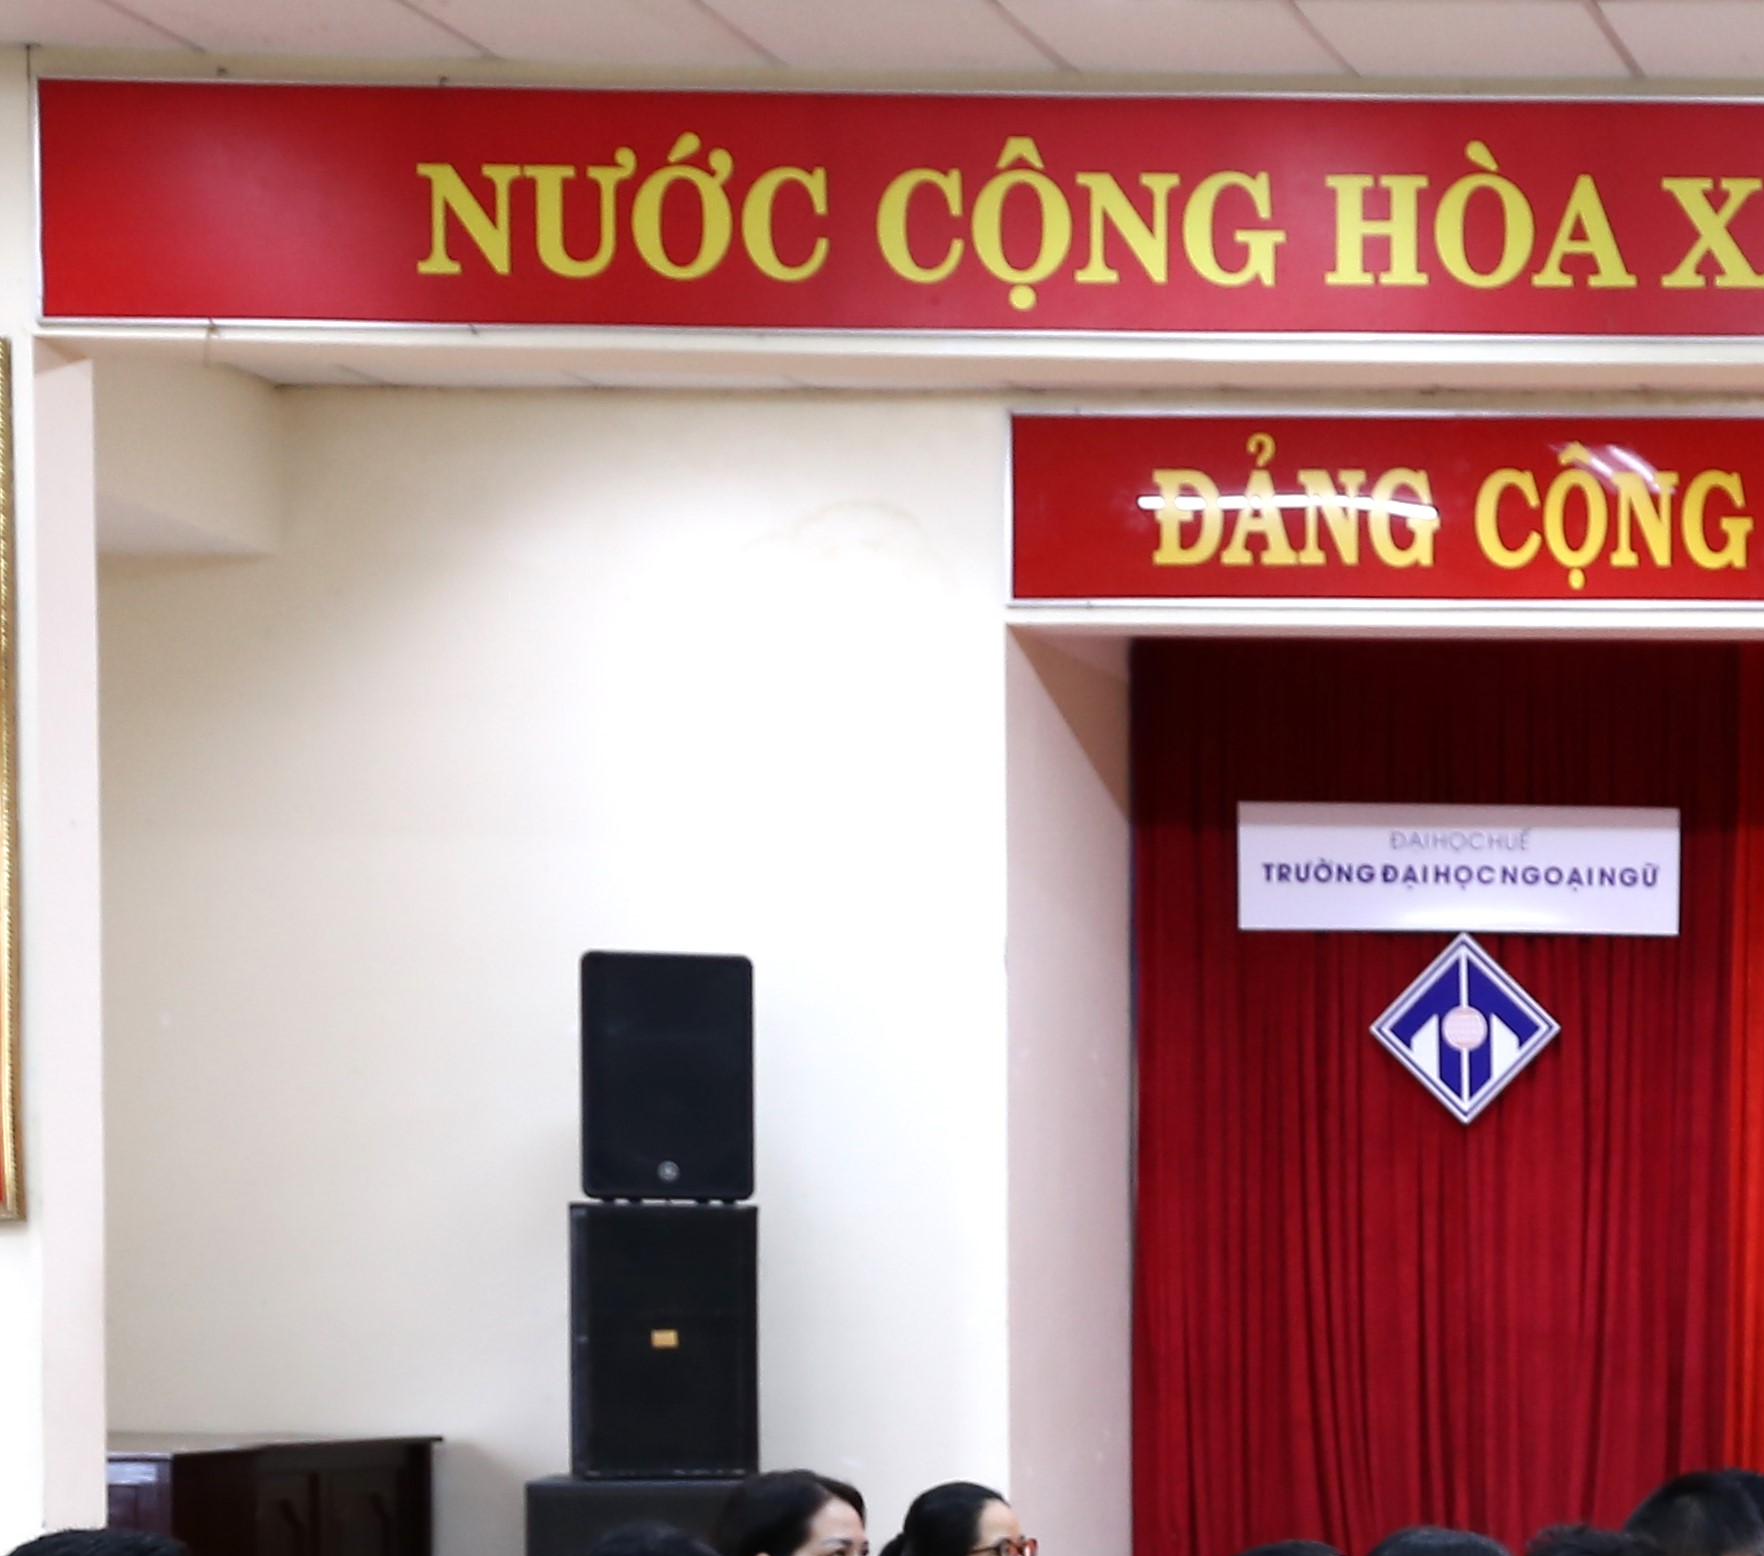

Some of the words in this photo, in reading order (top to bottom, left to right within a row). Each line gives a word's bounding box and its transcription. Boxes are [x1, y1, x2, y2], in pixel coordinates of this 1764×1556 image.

[417, 135, 829, 281] NƯỚC
[877, 138, 1287, 311] CỘNG
[1324, 142, 1638, 289] HÒA
[1153, 437, 1441, 569] ĐẢNG
[1475, 442, 1754, 591] CỘNG
[1263, 856, 1375, 883] TRƯỜNG
[1382, 864, 1428, 890] ĐẠI
[1434, 864, 1496, 891] HỌC
[1502, 866, 1593, 892] NGOẠI
[1600, 862, 1659, 888] NGỮ
